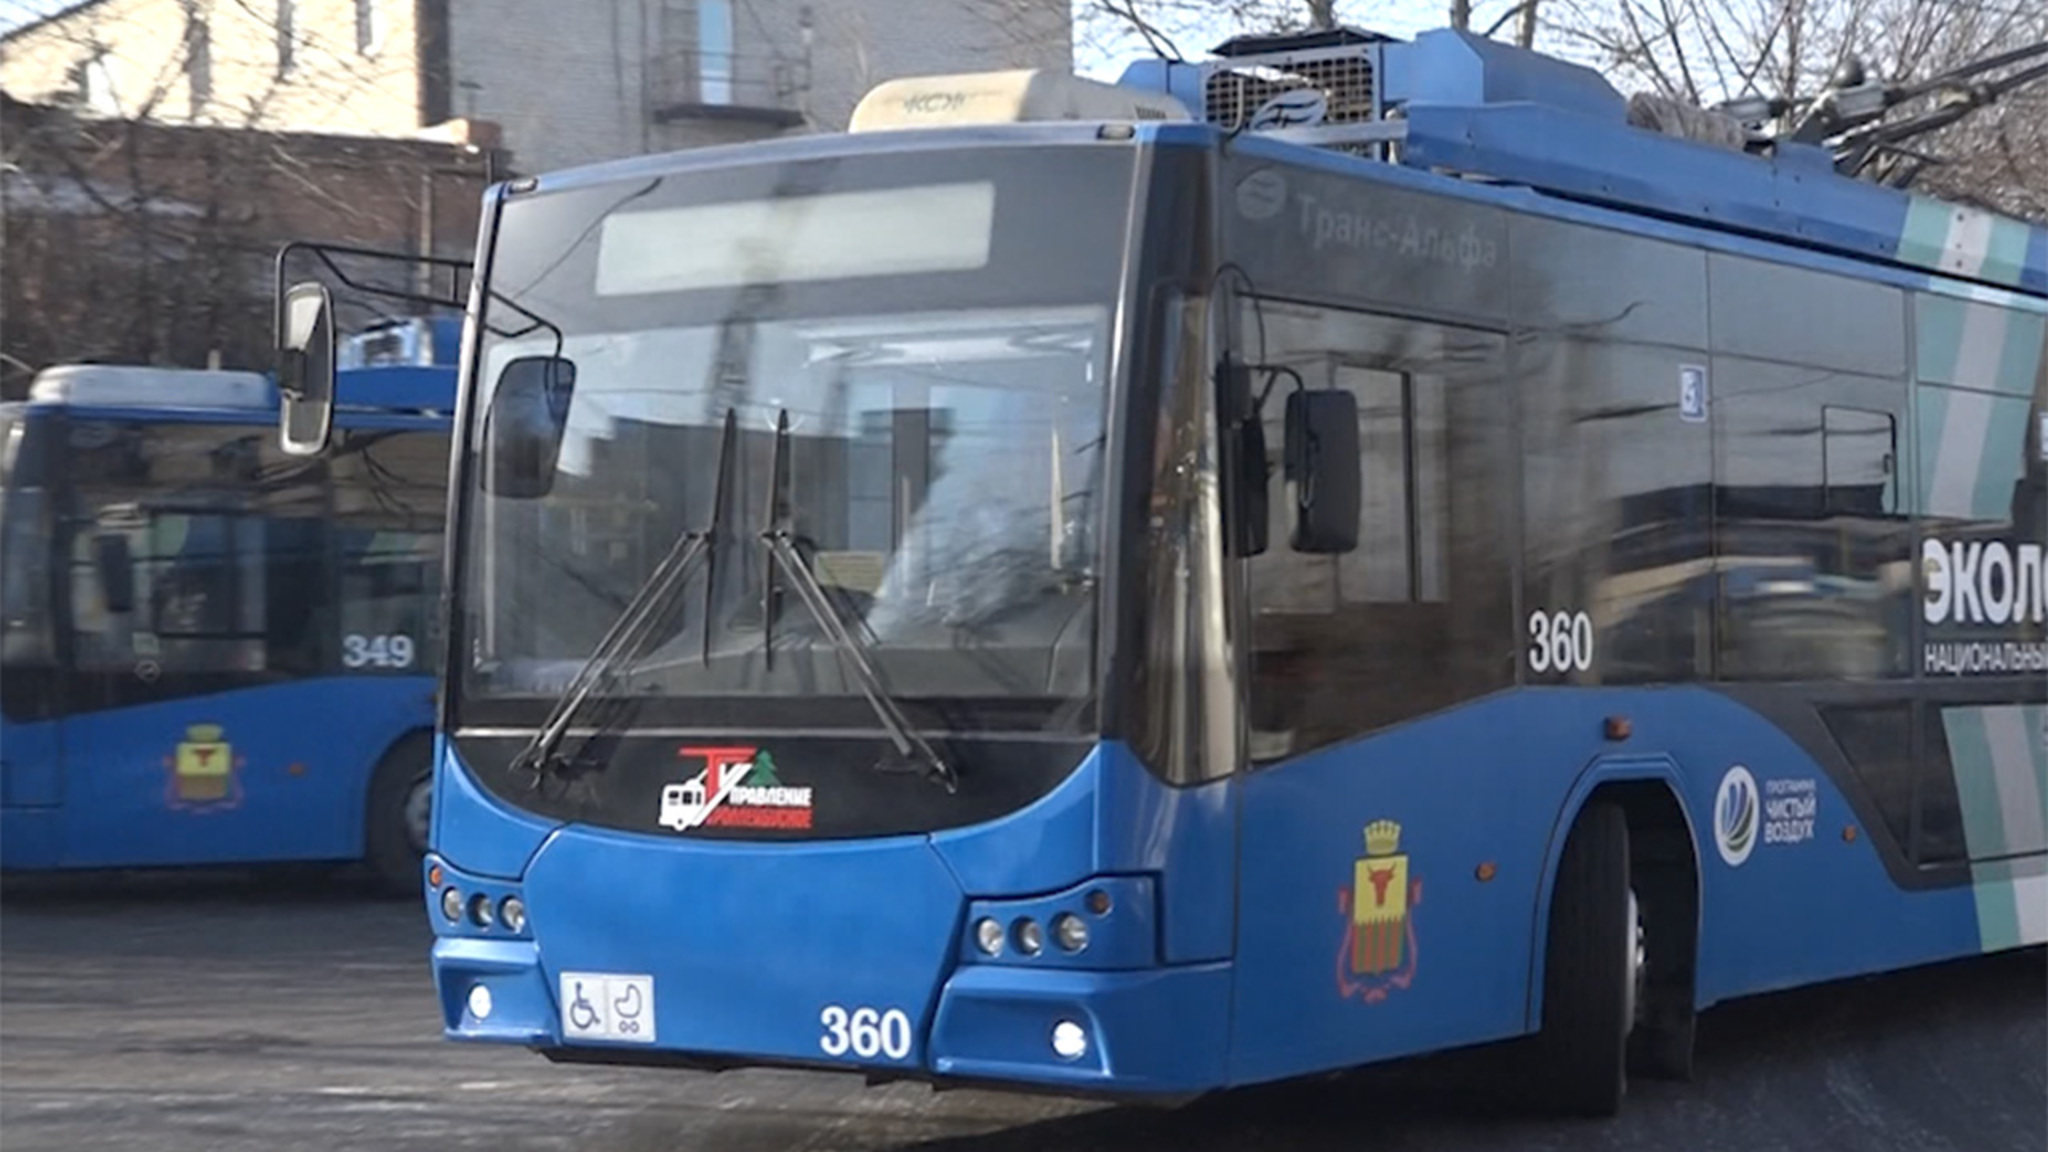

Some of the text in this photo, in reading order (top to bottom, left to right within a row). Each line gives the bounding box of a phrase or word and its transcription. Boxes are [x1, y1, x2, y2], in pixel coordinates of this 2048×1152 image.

[1296, 192, 1497, 274] Транс-Альфа
[1922, 537, 2048, 624] ЭКОЛ
[342, 634, 414, 667] 349
[1529, 610, 1593, 671] 360
[1764, 820, 1815, 844] ВОЗДУХ
[1765, 793, 1817, 818] ЧИСТЫЙ
[820, 1005, 912, 1059] 360
